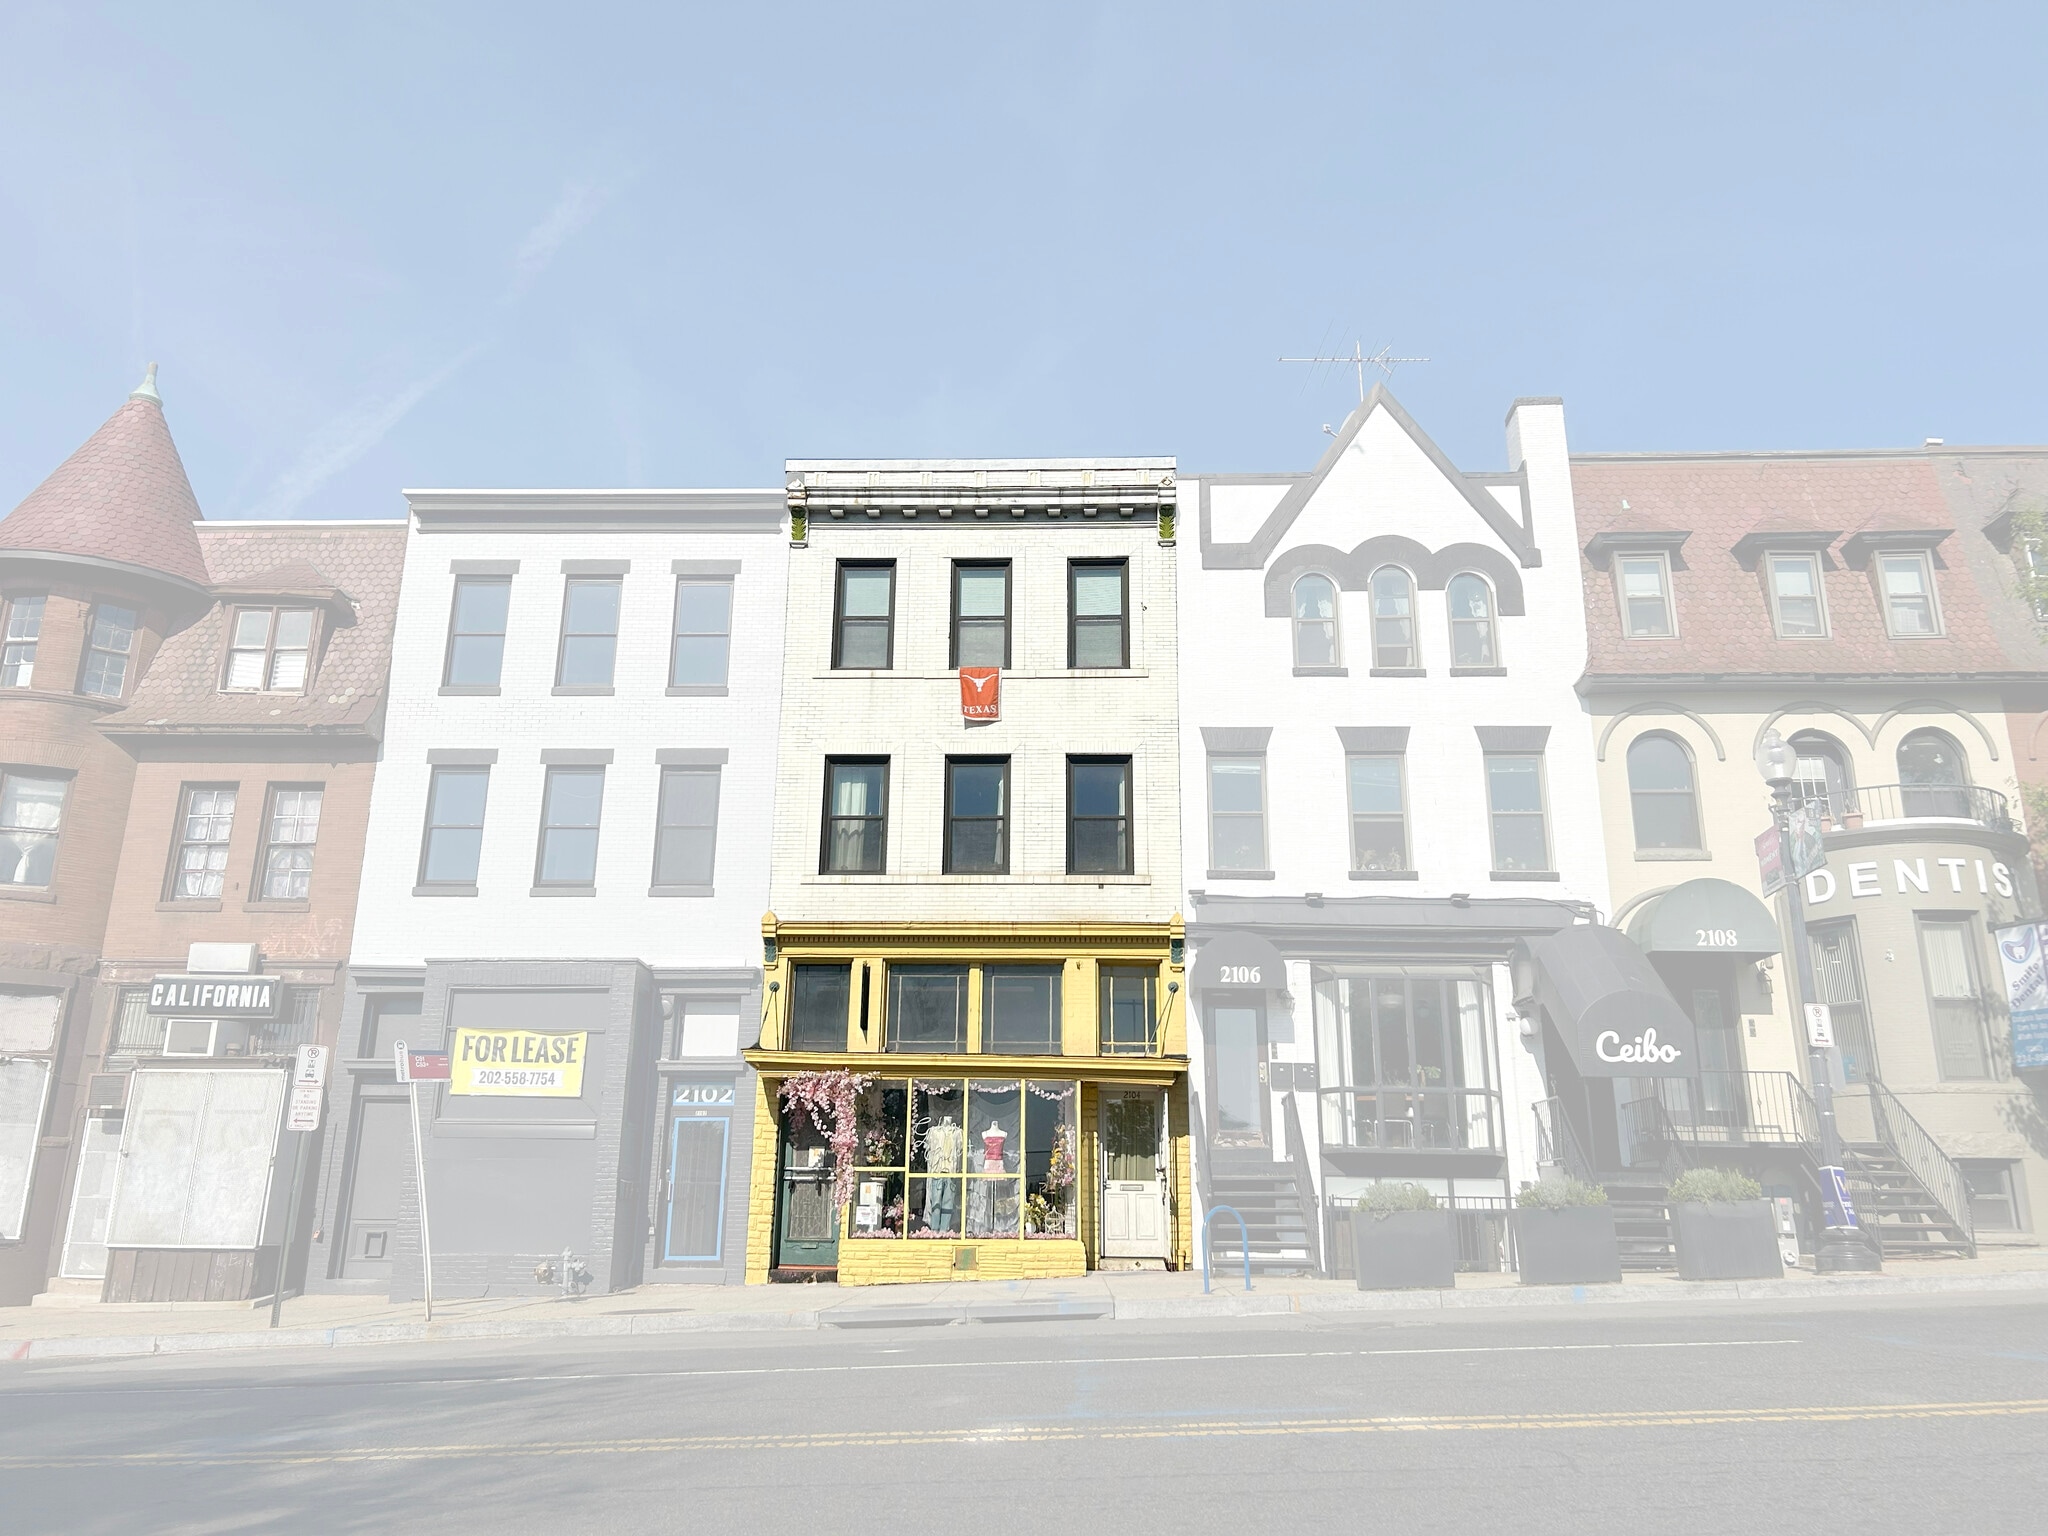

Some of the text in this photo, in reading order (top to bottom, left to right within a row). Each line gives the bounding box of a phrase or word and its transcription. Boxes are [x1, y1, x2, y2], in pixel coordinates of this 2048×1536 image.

[963, 705, 997, 714] TEXAS
[1695, 929, 1738, 947] 2108
[1220, 965, 1261, 984] 2106
[2012, 962, 2040, 991] Smile
[151, 983, 270, 1008] CALIFORNIA
[2011, 973, 2045, 1009] Dental
[462, 1034, 579, 1064] FOR LEASE
[1595, 1027, 1682, 1063] Ceibo
[478, 1070, 555, 1085] 202-558-7754
[676, 1086, 733, 1103] 2102
[1123, 1090, 1141, 1099] 2104
